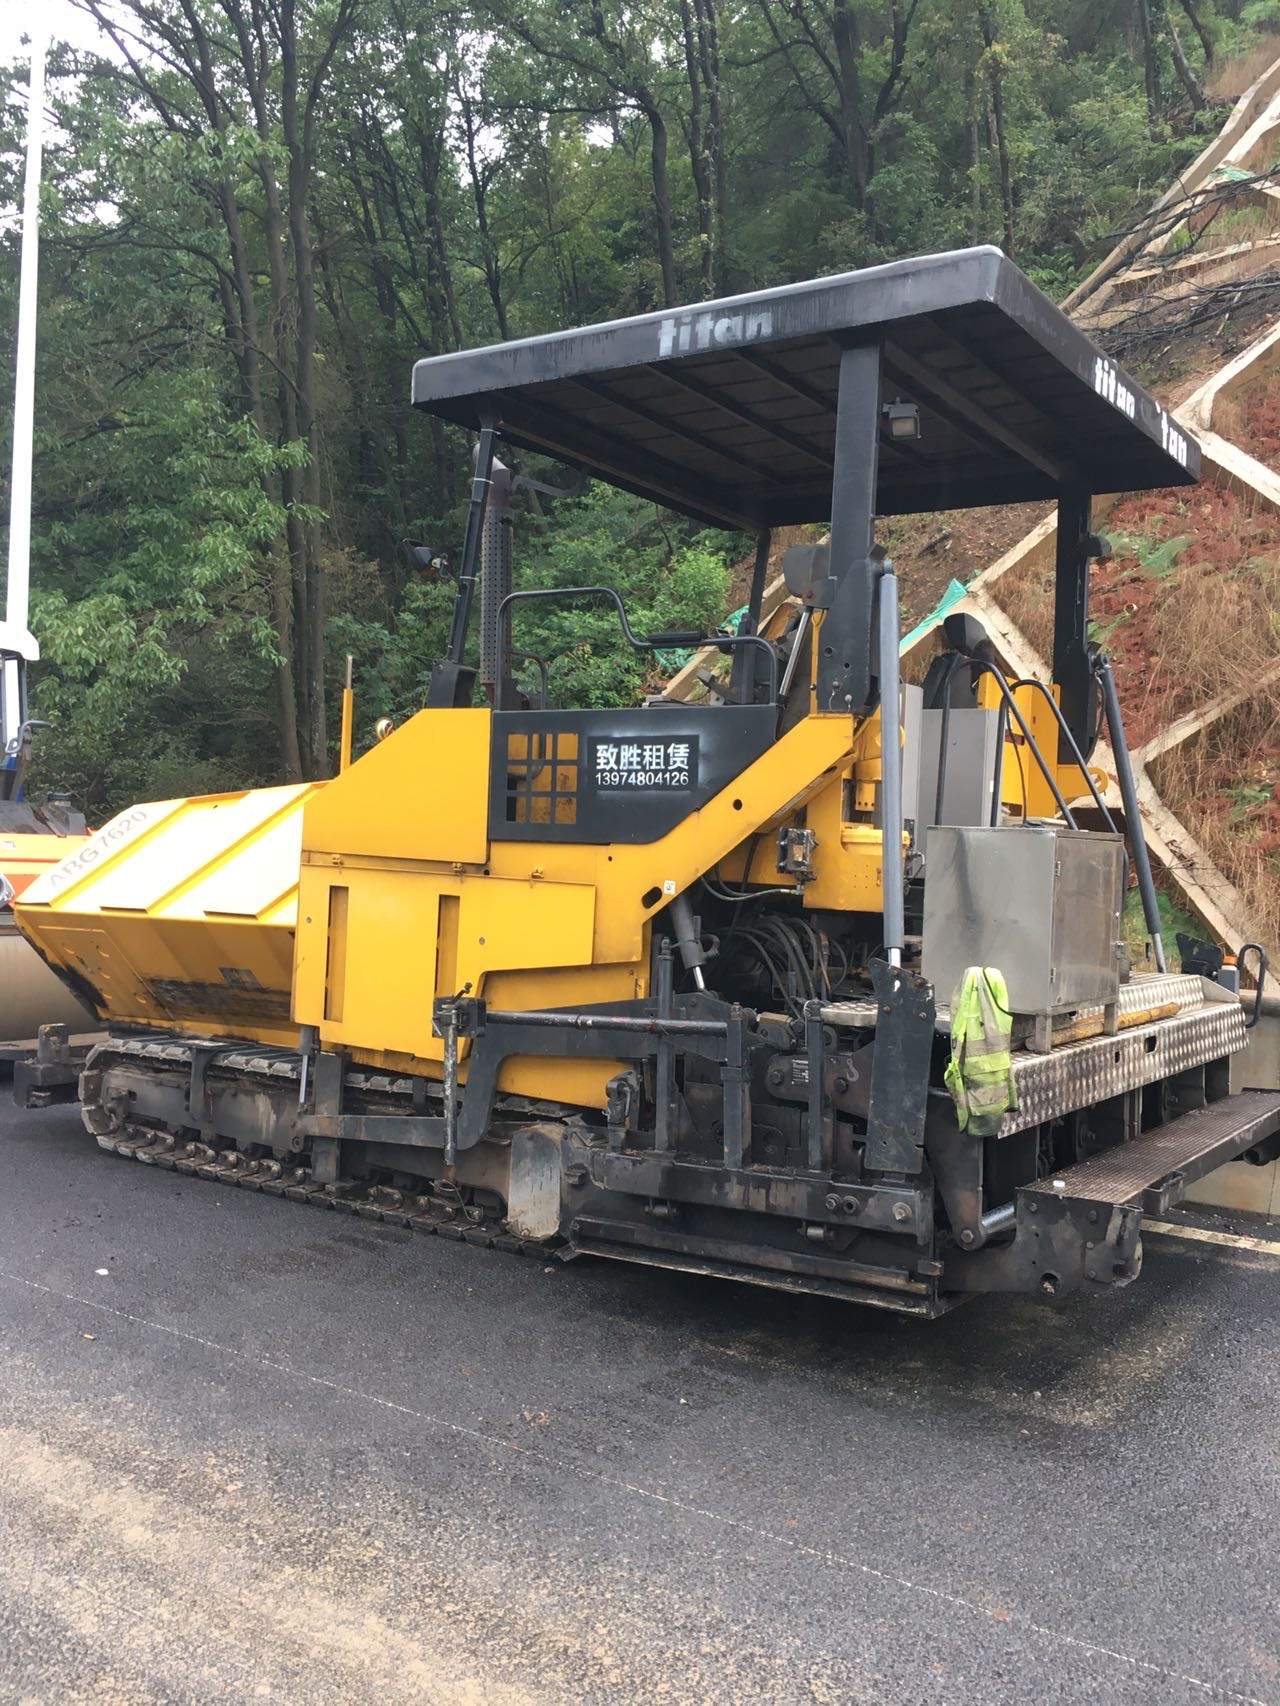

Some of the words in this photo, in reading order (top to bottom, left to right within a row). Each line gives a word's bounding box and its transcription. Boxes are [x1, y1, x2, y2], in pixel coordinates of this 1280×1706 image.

[658, 311, 773, 357] titan
[1094, 356, 1136, 420] titan
[596, 743, 690, 770] 致胜租赁
[595, 772, 689, 786] 13974804126
